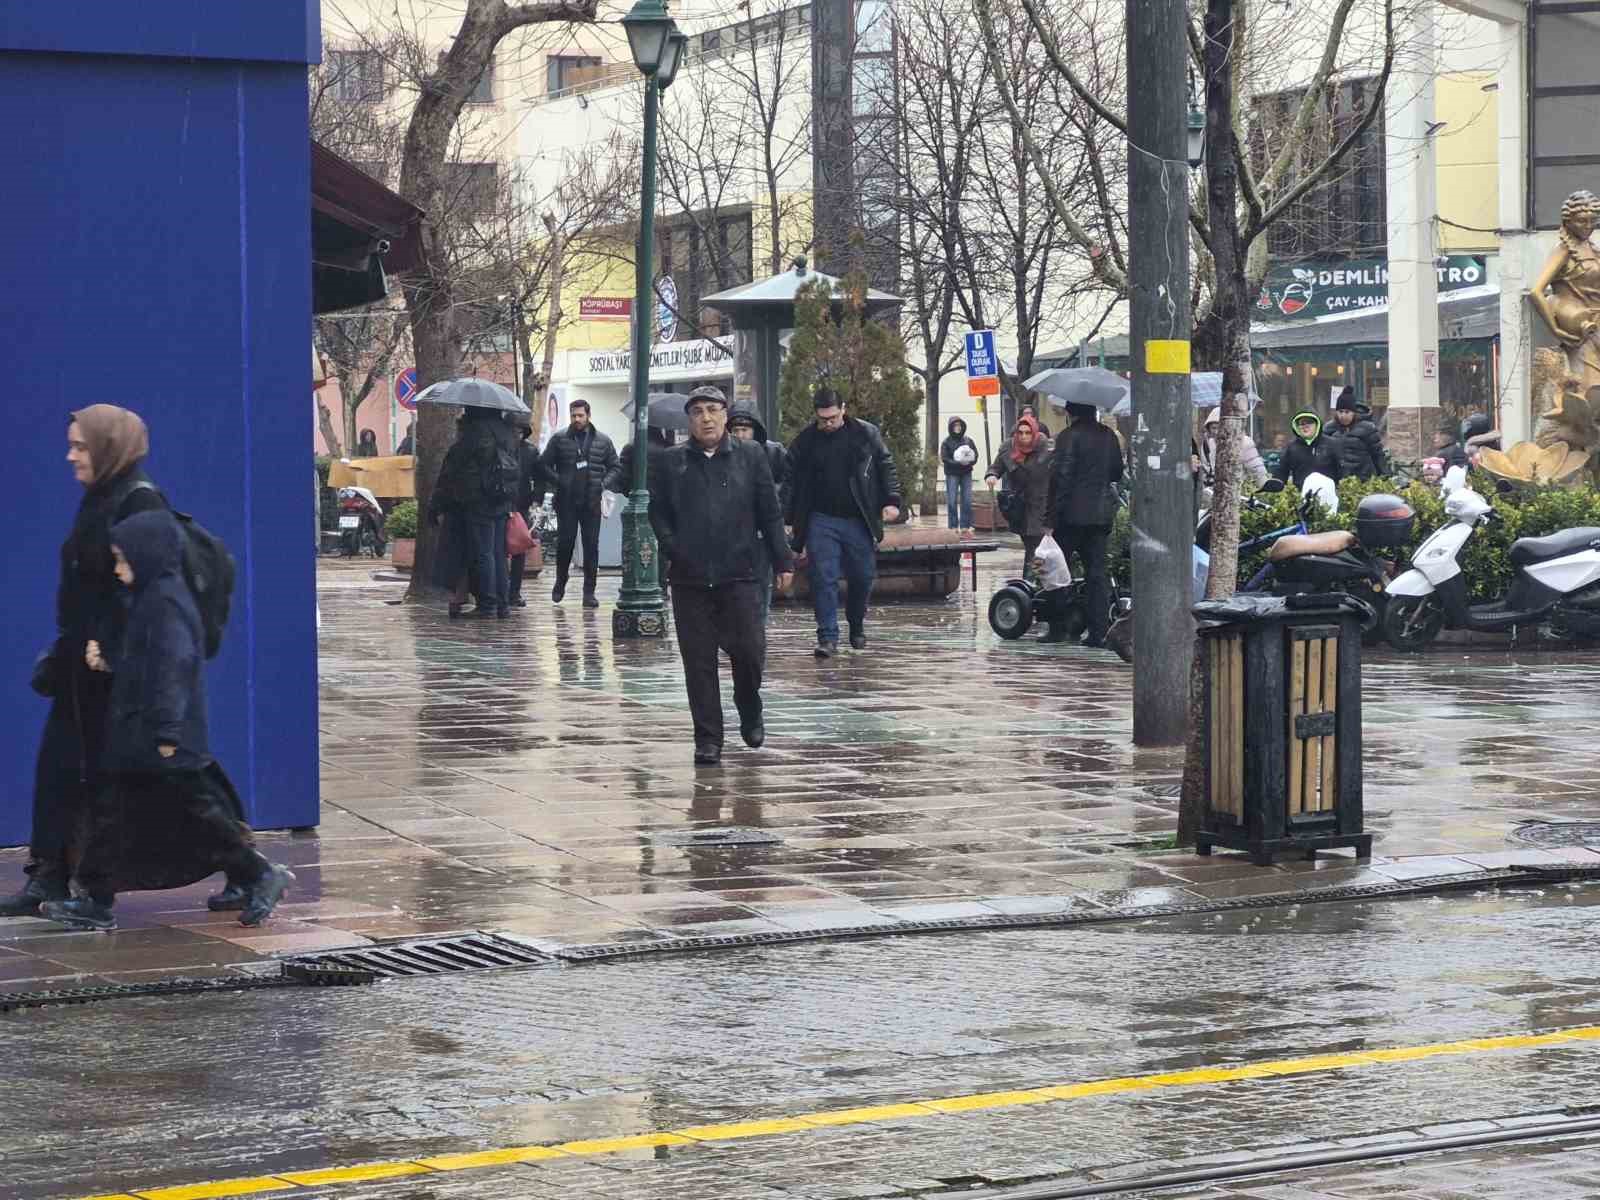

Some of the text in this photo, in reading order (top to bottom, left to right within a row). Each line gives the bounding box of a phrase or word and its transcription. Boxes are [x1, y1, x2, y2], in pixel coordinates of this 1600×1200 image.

[1437, 266, 1479, 282] TRO
[974, 333, 983, 349] D
[589, 356, 615, 372] SOSYAL
[615, 354, 632, 369] YARD
[649, 347, 682, 368] ZMETLERİ
[684, 346, 703, 367] ŞUBE
